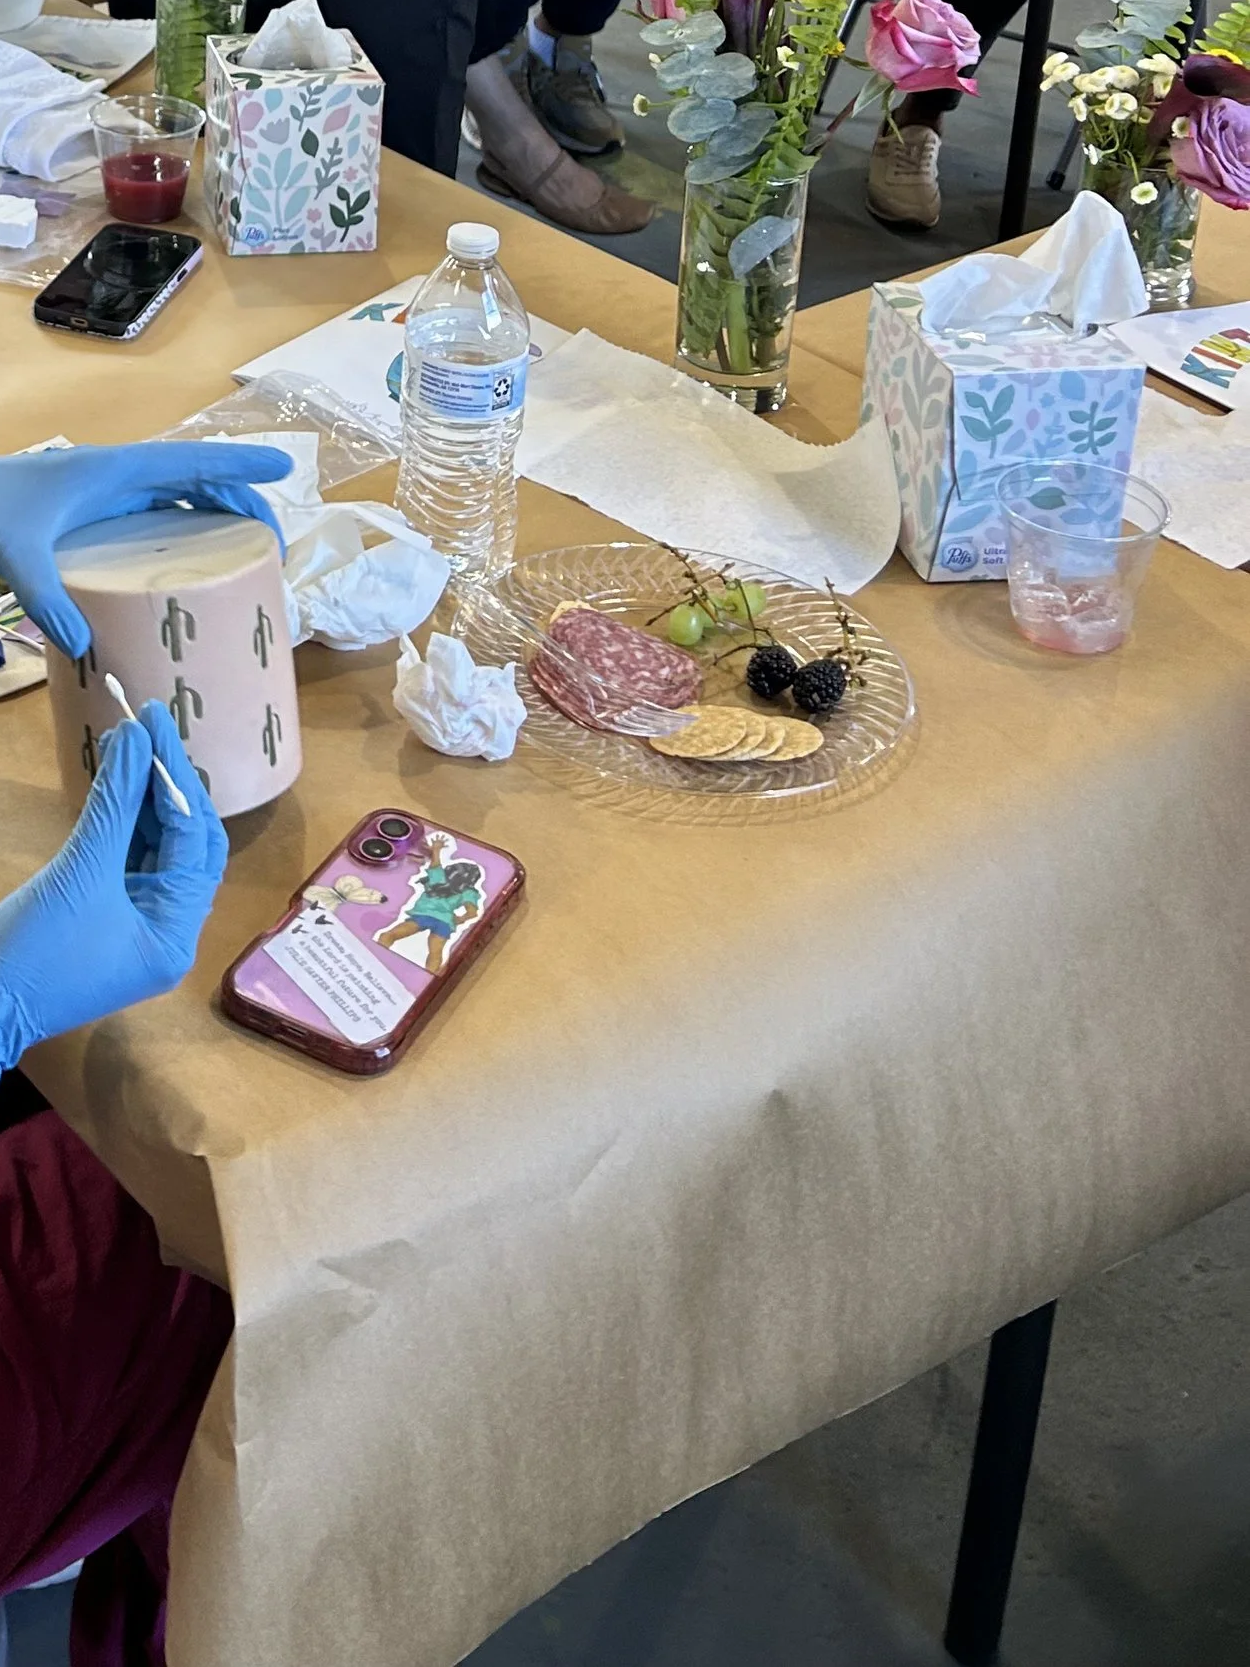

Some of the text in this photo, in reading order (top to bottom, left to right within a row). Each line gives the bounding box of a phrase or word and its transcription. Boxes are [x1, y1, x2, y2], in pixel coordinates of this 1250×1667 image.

[947, 547, 972, 565] Puffs
[982, 556, 1004, 565] Soft
[304, 945, 339, 981] beautiful
[336, 979, 361, 1003] future
[359, 1003, 374, 1015] for
[322, 947, 342, 964] Lord
[345, 973, 381, 1005] painting
